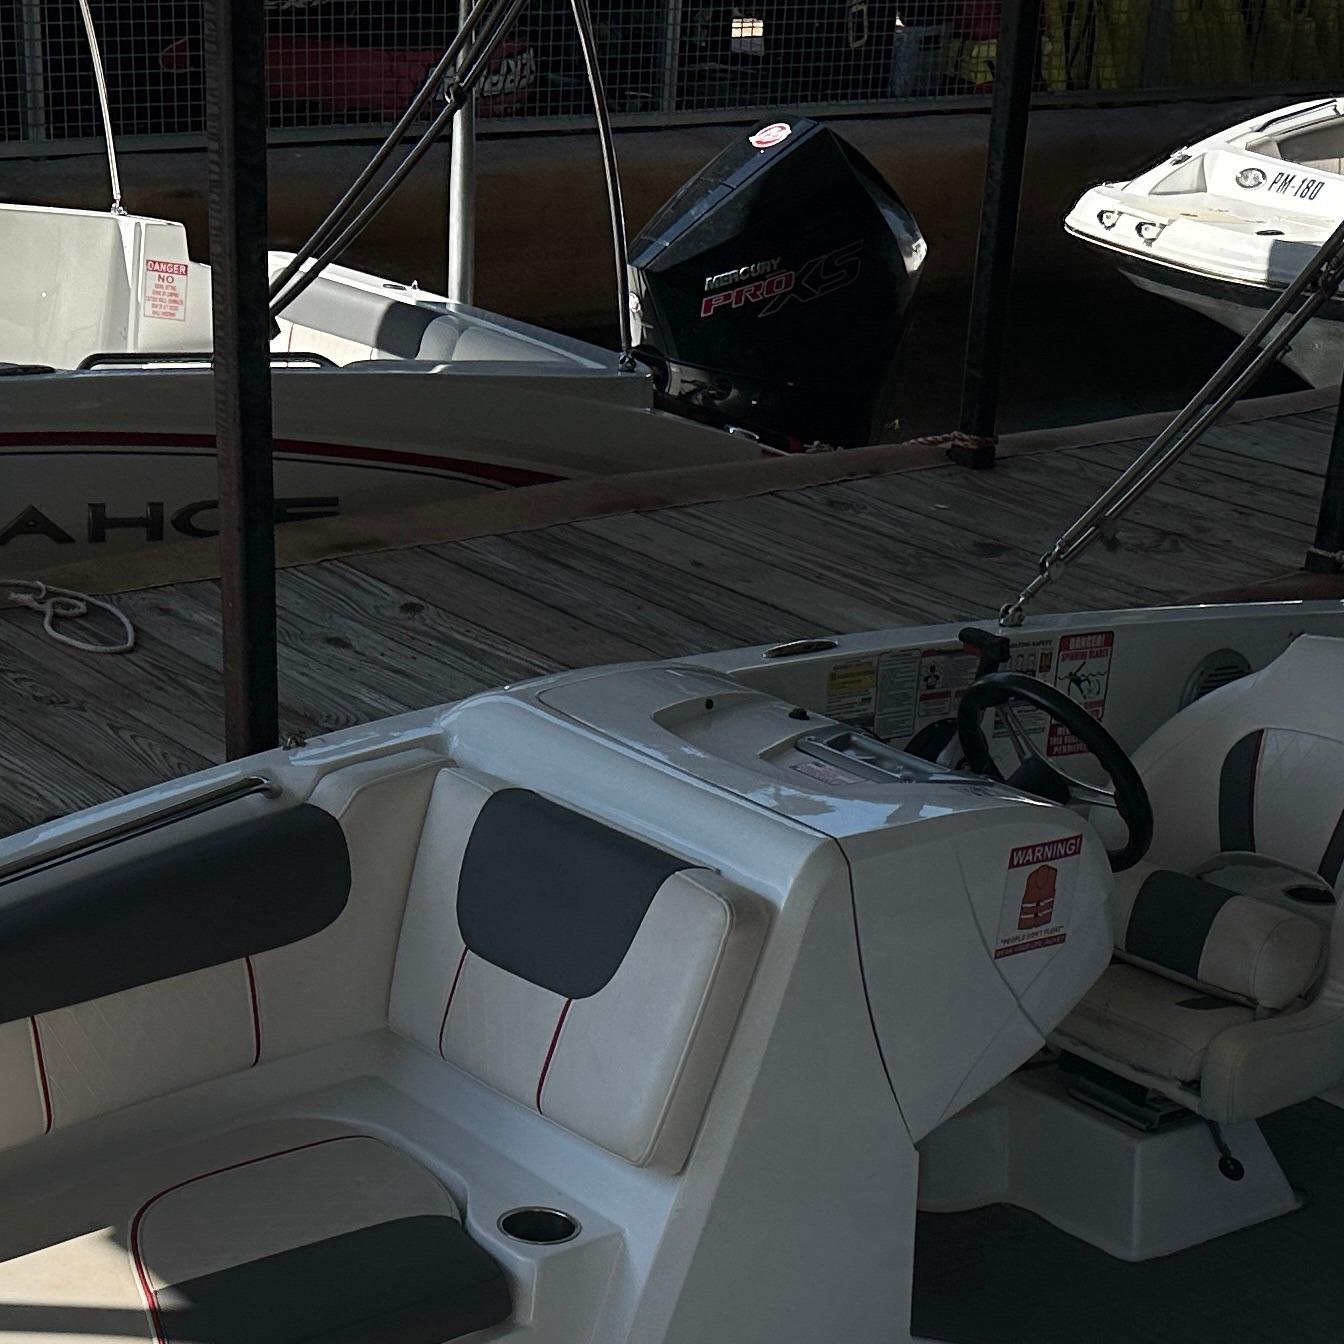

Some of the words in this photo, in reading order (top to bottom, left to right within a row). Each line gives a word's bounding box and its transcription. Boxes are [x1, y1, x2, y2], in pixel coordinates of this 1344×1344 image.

[1267, 172, 1326, 200] PM-180
[147, 261, 187, 275] DANGER
[157, 273, 175, 284] NO
[704, 256, 785, 291] MERCURY
[1014, 837, 1081, 866] WARNING!
